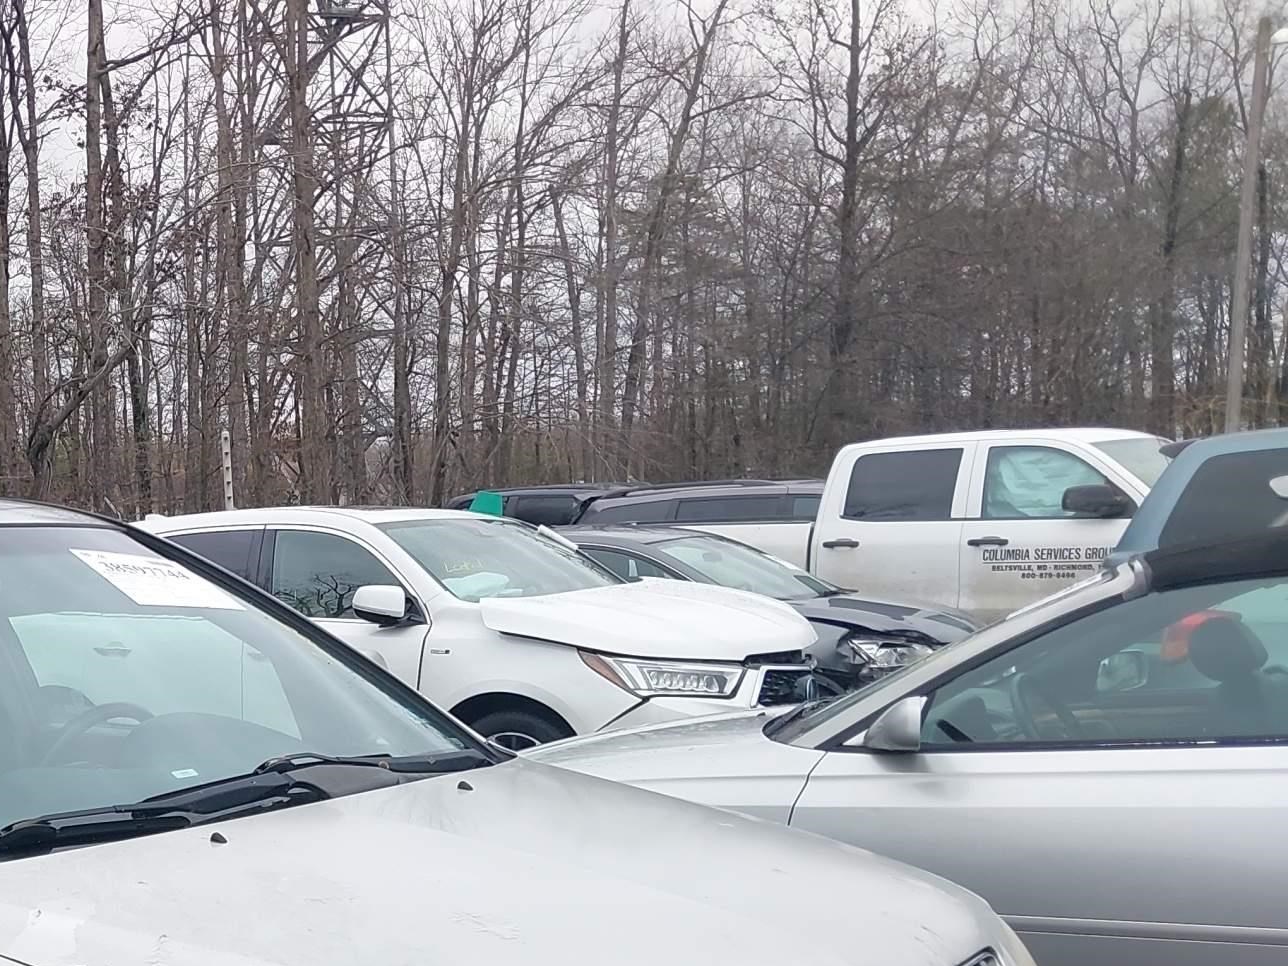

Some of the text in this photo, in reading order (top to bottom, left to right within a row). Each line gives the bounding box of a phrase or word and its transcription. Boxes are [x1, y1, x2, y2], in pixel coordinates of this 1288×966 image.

[982, 547, 1112, 561] COLUMBIA SERVICES GROU
